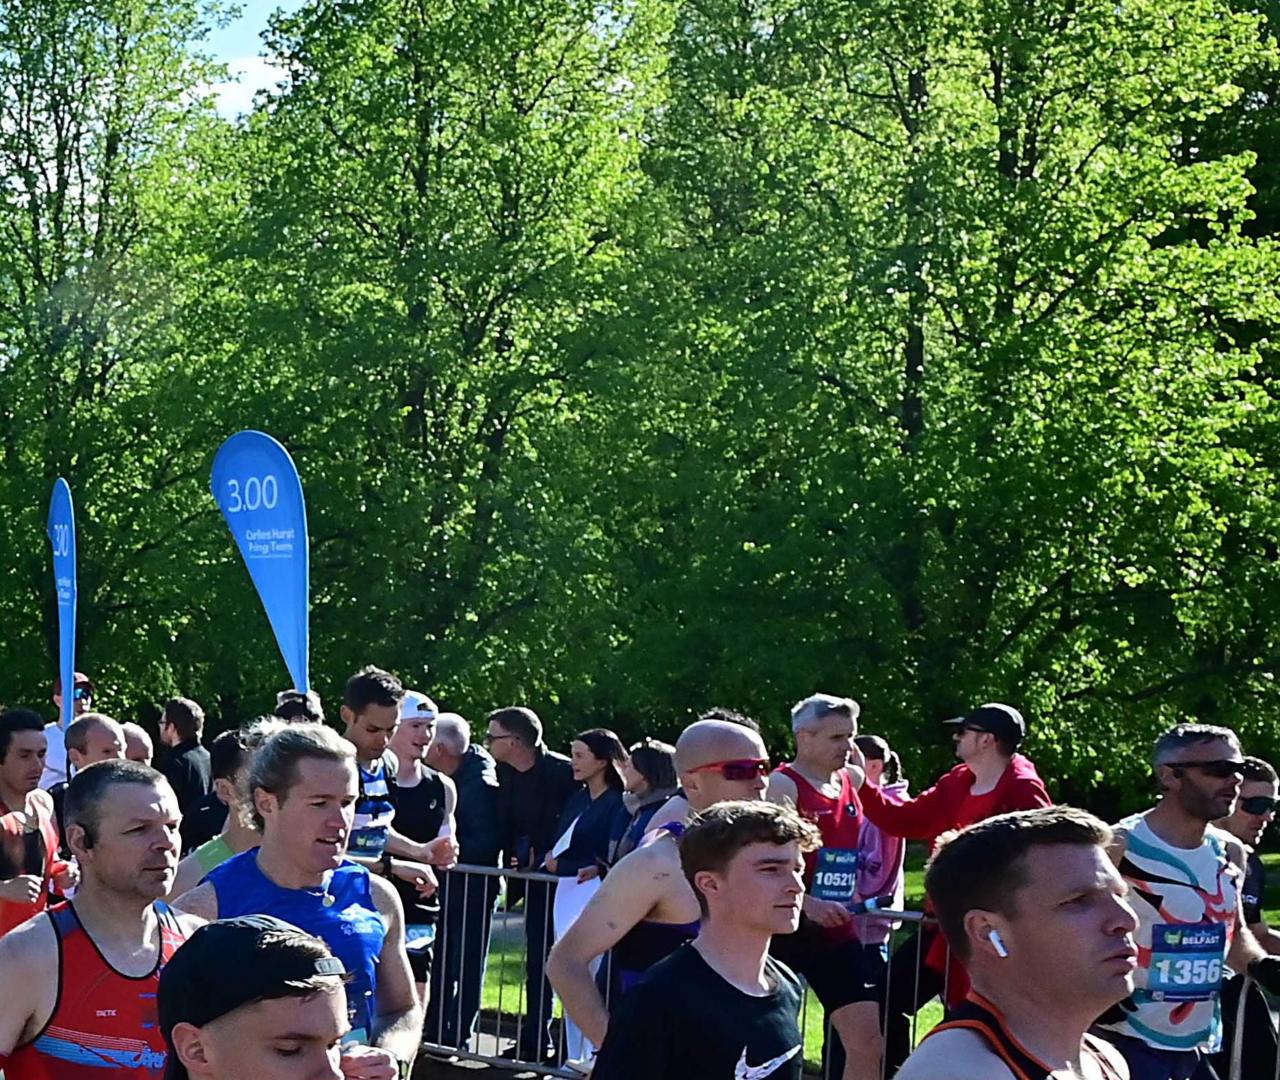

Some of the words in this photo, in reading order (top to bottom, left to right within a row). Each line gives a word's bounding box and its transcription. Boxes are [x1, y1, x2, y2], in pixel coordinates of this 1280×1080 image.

[227, 474, 278, 513] 3.00
[1182, 936, 1219, 944] BELFAST
[1156, 959, 1220, 984] 1356
